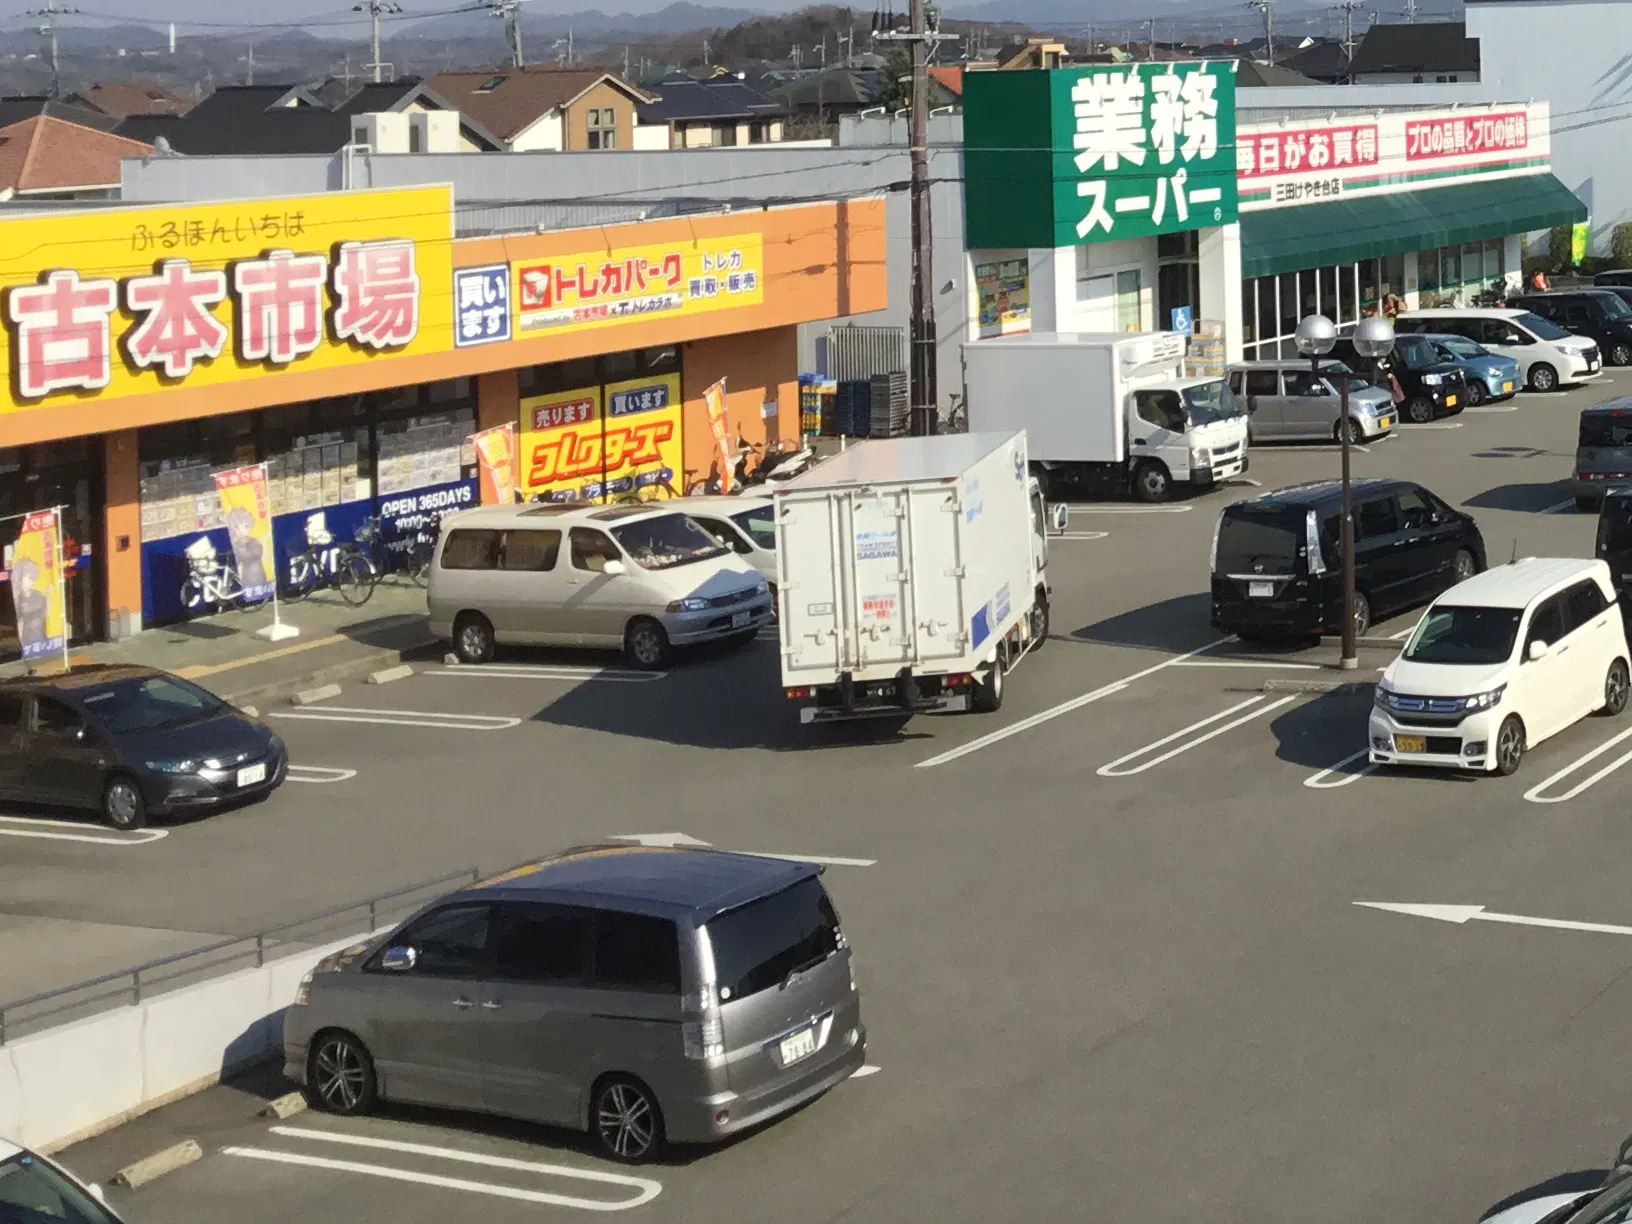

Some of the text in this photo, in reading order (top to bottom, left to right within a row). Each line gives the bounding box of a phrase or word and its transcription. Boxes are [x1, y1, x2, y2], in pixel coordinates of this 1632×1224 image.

[1071, 71, 1219, 173] 業務
[1408, 115, 1526, 156] プロの品質とプロの価格
[1236, 127, 1377, 175] 毎日がお買得
[1075, 167, 1222, 239] スーパー
[1275, 178, 1340, 202] 三田けやき台店
[131, 210, 306, 252] ふるほんいちば
[555, 253, 683, 302] トレカパーク
[702, 250, 742, 273] トレカ
[9, 238, 421, 399] 古本市場
[536, 402, 591, 429] 売ります
[614, 389, 665, 415] 買います
[528, 420, 674, 487] コレクターズ
[382, 485, 472, 518] OPEN 365DAYS
[856, 550, 898, 560] SAGAWA
